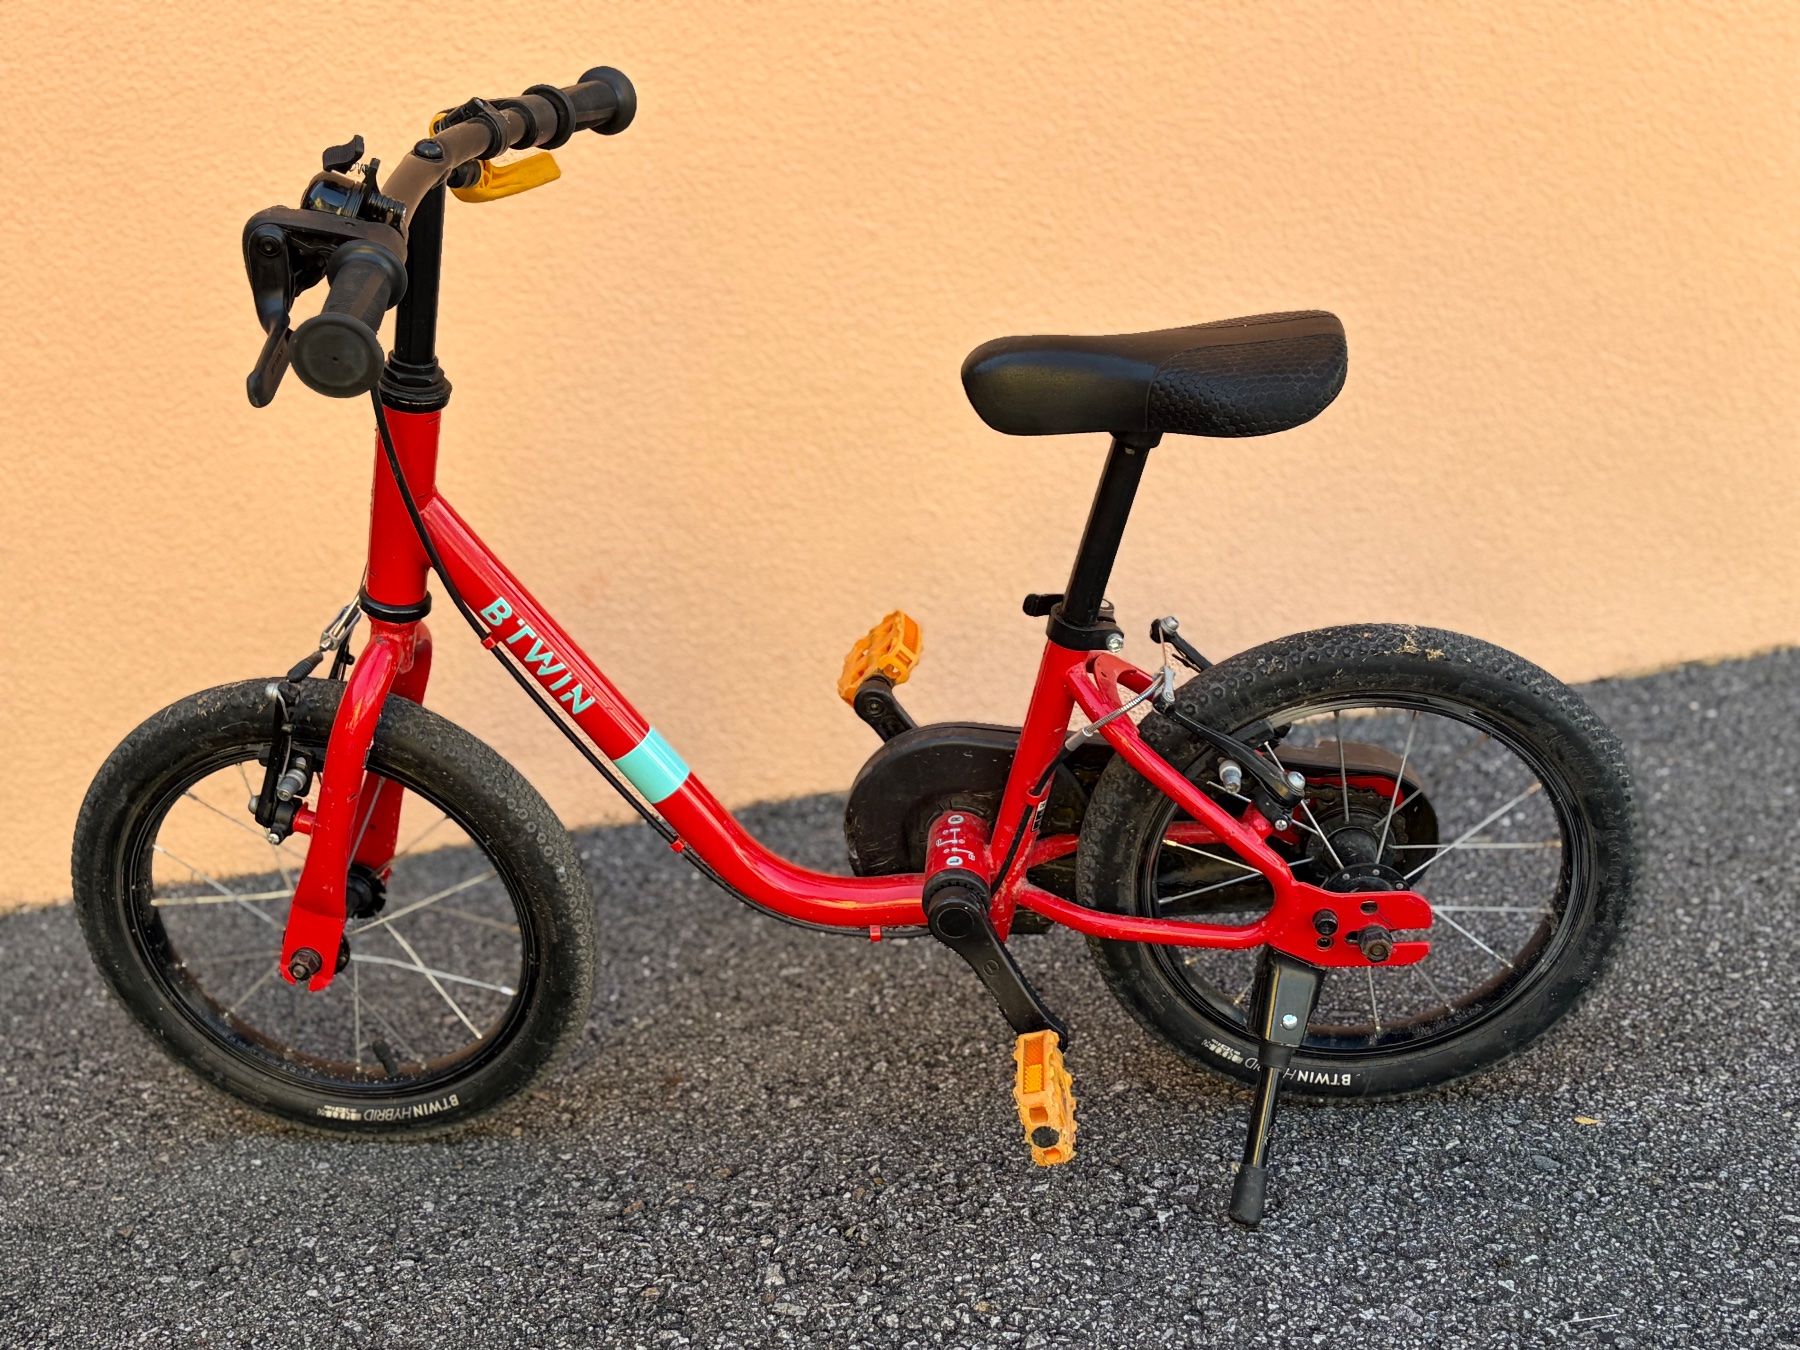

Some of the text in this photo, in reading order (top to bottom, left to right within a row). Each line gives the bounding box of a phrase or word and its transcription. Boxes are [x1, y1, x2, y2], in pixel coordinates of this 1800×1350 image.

[1297, 1070, 1351, 1086] BTWIN
[363, 1106, 413, 1121] HYBRID
[413, 1094, 460, 1118] BTWIN
